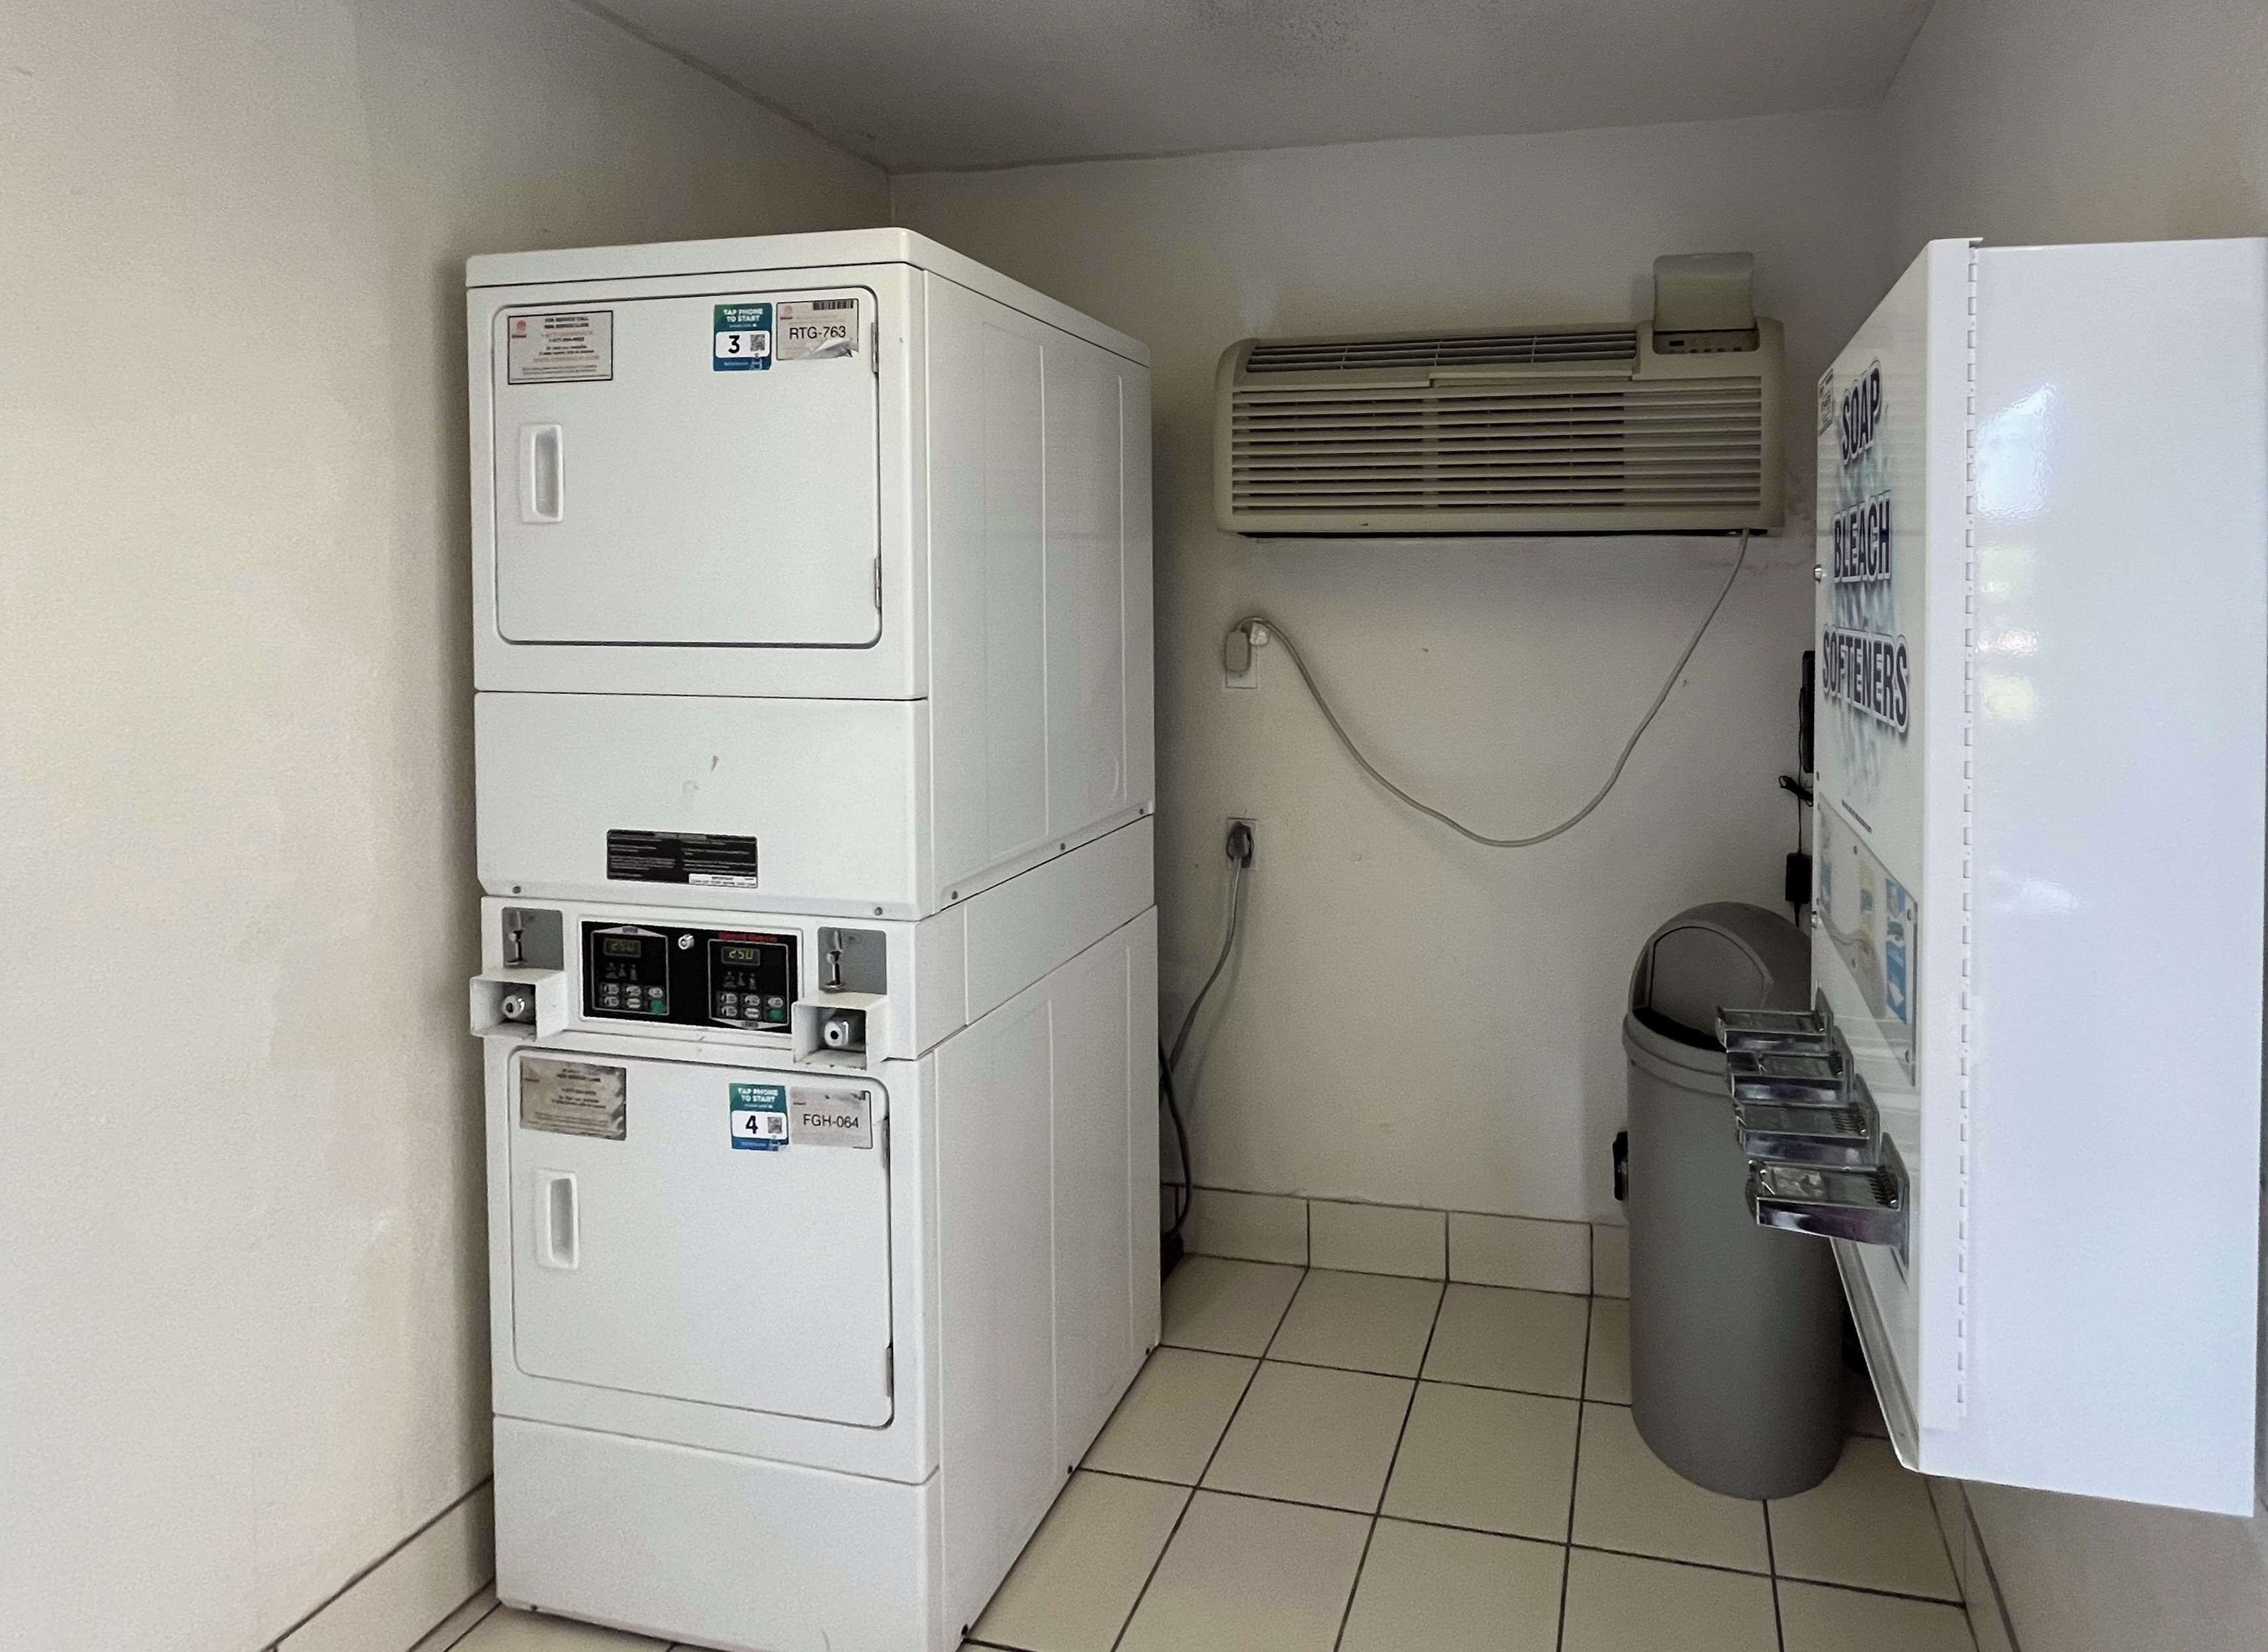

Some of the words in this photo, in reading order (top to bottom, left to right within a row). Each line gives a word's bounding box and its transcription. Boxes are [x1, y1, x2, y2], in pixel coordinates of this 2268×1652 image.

[789, 326, 847, 340] RTG-763
[728, 335, 740, 354] 3
[1841, 366, 1881, 462] SOAP
[1834, 495, 1891, 579] BLEACH
[1822, 625, 1909, 731] SOFTENERS
[753, 1088, 779, 1097] PHONE
[745, 1115, 759, 1134] 4
[803, 1114, 859, 1128] FGH-064
